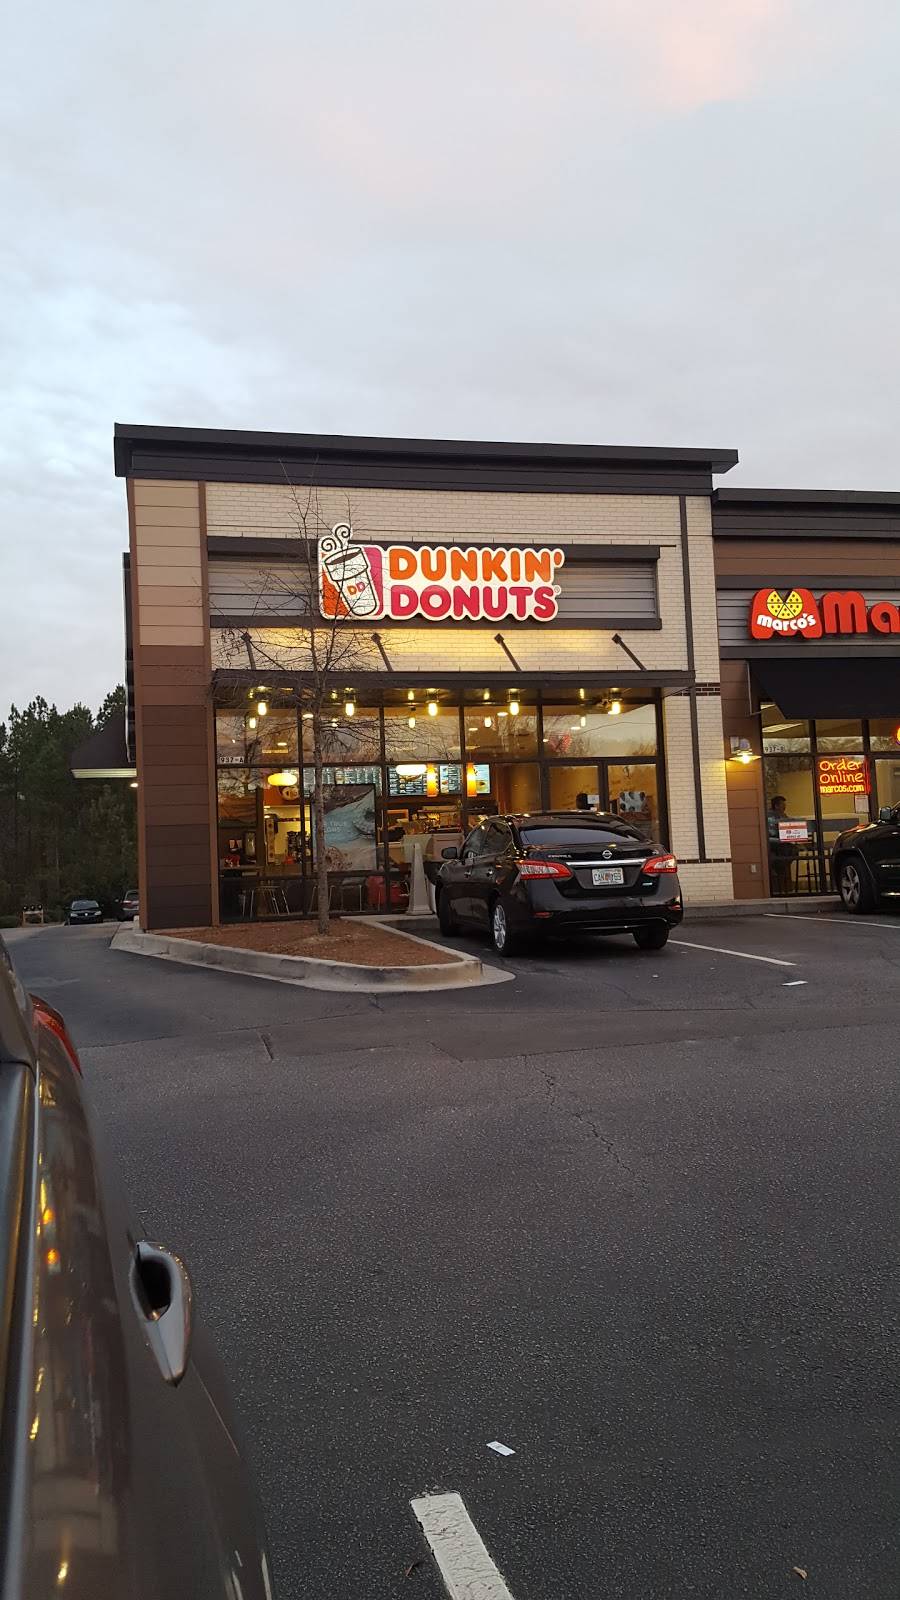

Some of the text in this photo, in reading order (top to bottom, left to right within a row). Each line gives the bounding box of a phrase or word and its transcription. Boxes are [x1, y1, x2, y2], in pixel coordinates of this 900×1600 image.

[389, 548, 562, 582] DUNKIN'
[347, 582, 365, 595] DD
[390, 585, 556, 618] DONUTS
[756, 613, 816, 631] marco's
[819, 758, 860, 771] Order
[819, 771, 864, 784] Online
[819, 784, 865, 794] marcos.com
